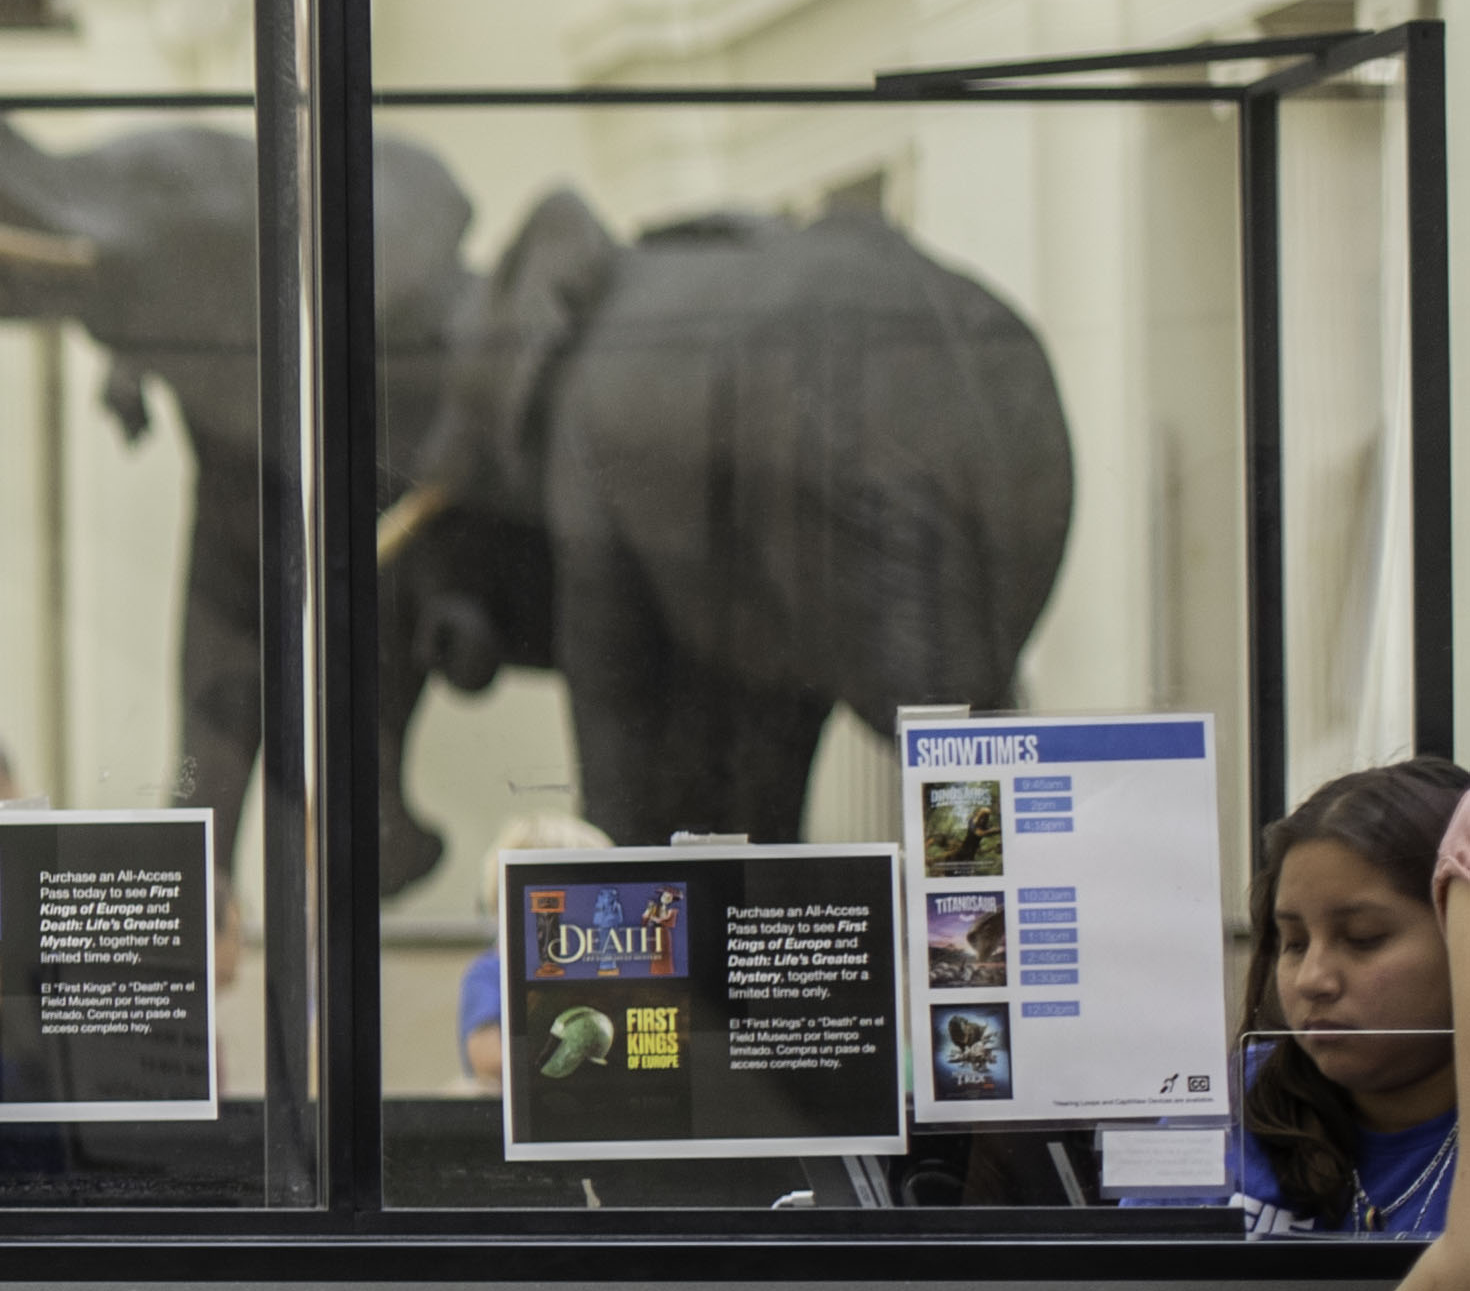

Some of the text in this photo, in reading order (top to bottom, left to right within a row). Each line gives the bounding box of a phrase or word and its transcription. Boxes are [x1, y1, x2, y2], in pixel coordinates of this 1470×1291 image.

[917, 735, 1038, 766] SHOWTIMES
[40, 870, 182, 884] Purchase an All-Access
[40, 886, 179, 900] Pass today to see First
[40, 902, 170, 917] Kings of Europe and
[727, 905, 869, 919] Purchase an All-Access
[935, 896, 997, 915] TITANOSAUR
[40, 918, 179, 932] Death: Life's Greatest
[727, 920, 867, 935] Pass today to see First
[40, 934, 180, 949] Mystery, together for a
[548, 924, 662, 964] DEATH
[728, 937, 858, 953] Kings of Europe and
[40, 951, 141, 965] limited time only.
[728, 953, 868, 967] Death: Life's Greatest
[728, 969, 869, 985] Mystery, together for a
[42, 983, 51, 993] El
[119, 984, 126, 992] o
[170, 983, 183, 992] en
[185, 982, 195, 992] el
[729, 986, 831, 1000] limited time only.
[42, 995, 169, 1008] Field Museum por tiempo
[42, 1008, 186, 1021] limitado. Compra un pase de
[626, 1007, 678, 1031] FIRST
[42, 1022, 152, 1035] acceso completo hoy.
[730, 1019, 739, 1029] El
[808, 1020, 815, 1028] o
[860, 1018, 872, 1026] en
[875, 1016, 884, 1026] el
[627, 1032, 679, 1054] KINGS
[730, 1031, 859, 1042] Field Museum por tiempo
[730, 1045, 773, 1055] limitado.
[776, 1044, 817, 1056] Compra
[835, 1045, 860, 1056] pase
[862, 1044, 876, 1053] de
[628, 1054, 679, 1069] OF EUROPE
[731, 1058, 841, 1070] acceso completo hoy.
